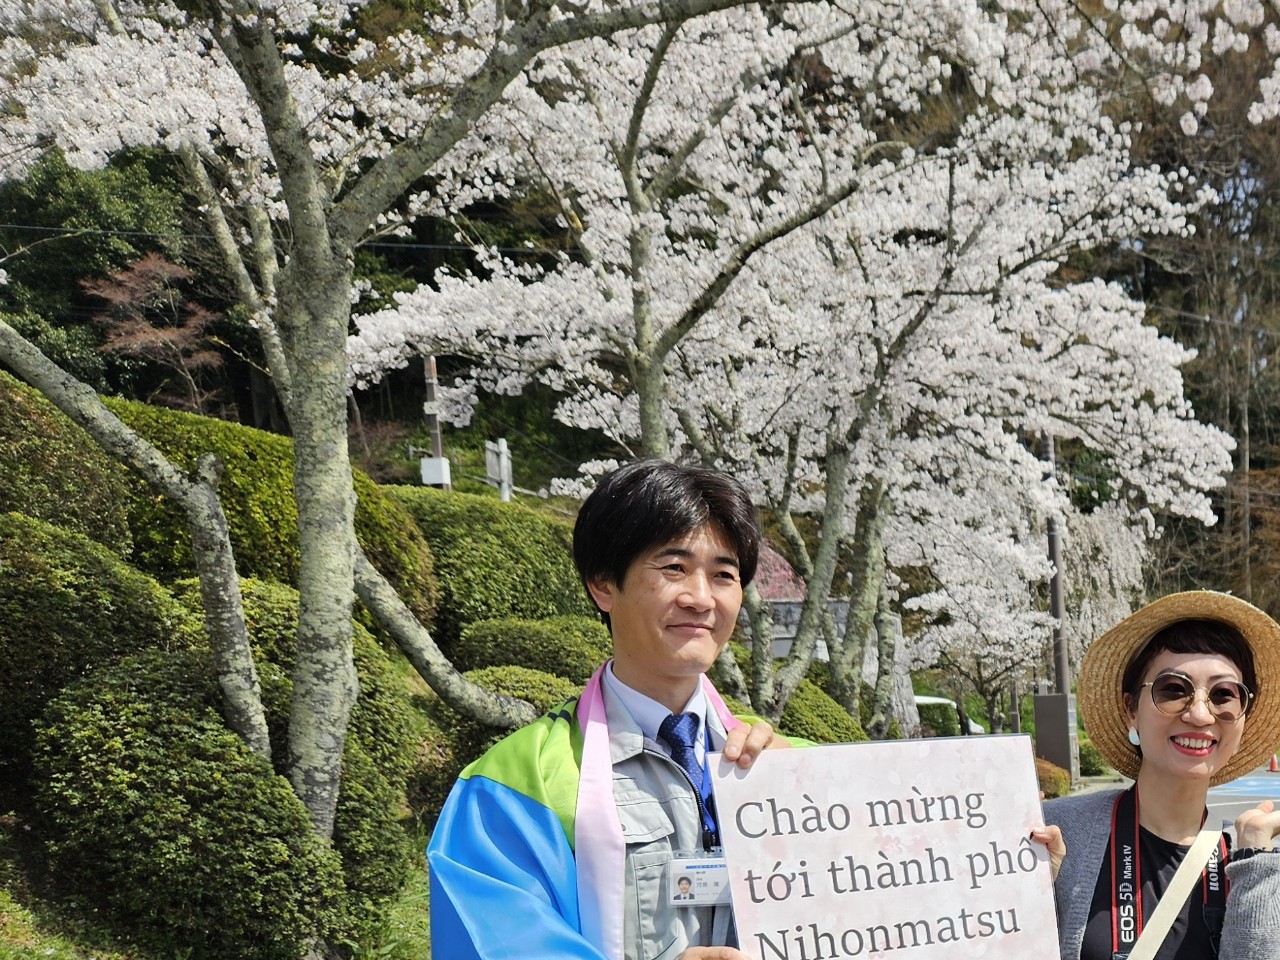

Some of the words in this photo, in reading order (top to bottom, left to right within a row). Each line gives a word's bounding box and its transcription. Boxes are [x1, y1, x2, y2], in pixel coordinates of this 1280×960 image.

[735, 793, 851, 839] Chào
[865, 785, 988, 829] mừng
[744, 860, 815, 904] tới
[827, 847, 954, 894] thành
[1123, 855, 1132, 879] Mark
[1119, 882, 1133, 901] 5D
[1120, 904, 1135, 943] EOS
